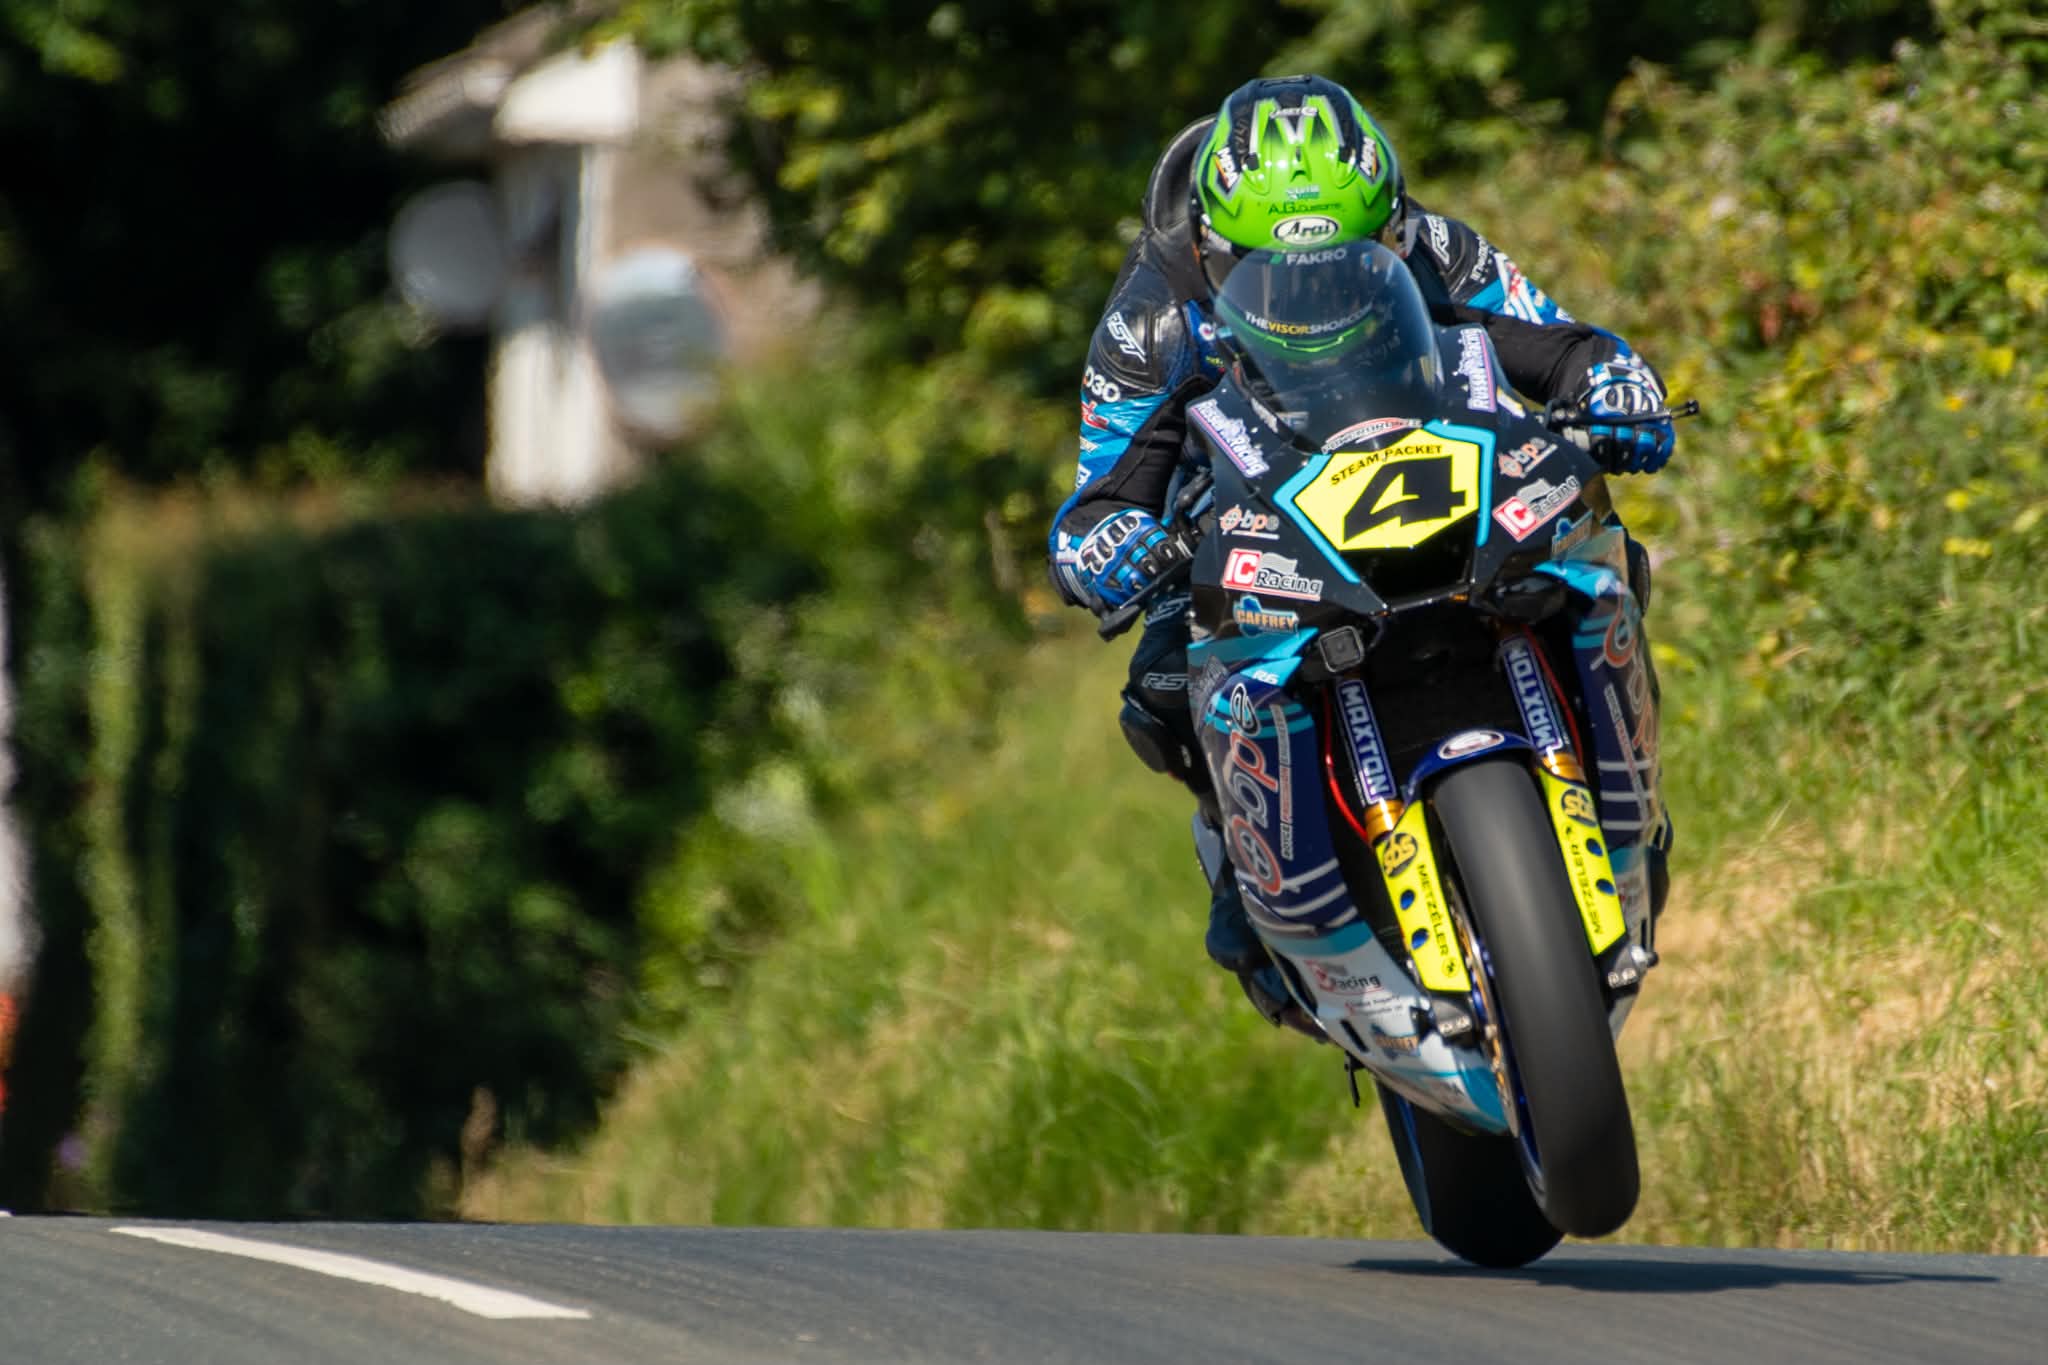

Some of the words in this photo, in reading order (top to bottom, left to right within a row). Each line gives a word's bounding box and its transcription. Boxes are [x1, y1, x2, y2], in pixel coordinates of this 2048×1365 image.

[1286, 219, 1333, 240] Arai
[1286, 248, 1347, 266] FAKRO
[1329, 452, 1381, 486] STEAM
[1384, 443, 1444, 461] PACKET
[1343, 455, 1466, 545] 4
[1256, 570, 1322, 595] Racing
[1509, 644, 1556, 747] MAXTON
[1341, 685, 1390, 796] MAXTON
[1417, 864, 1449, 956] METZELER
